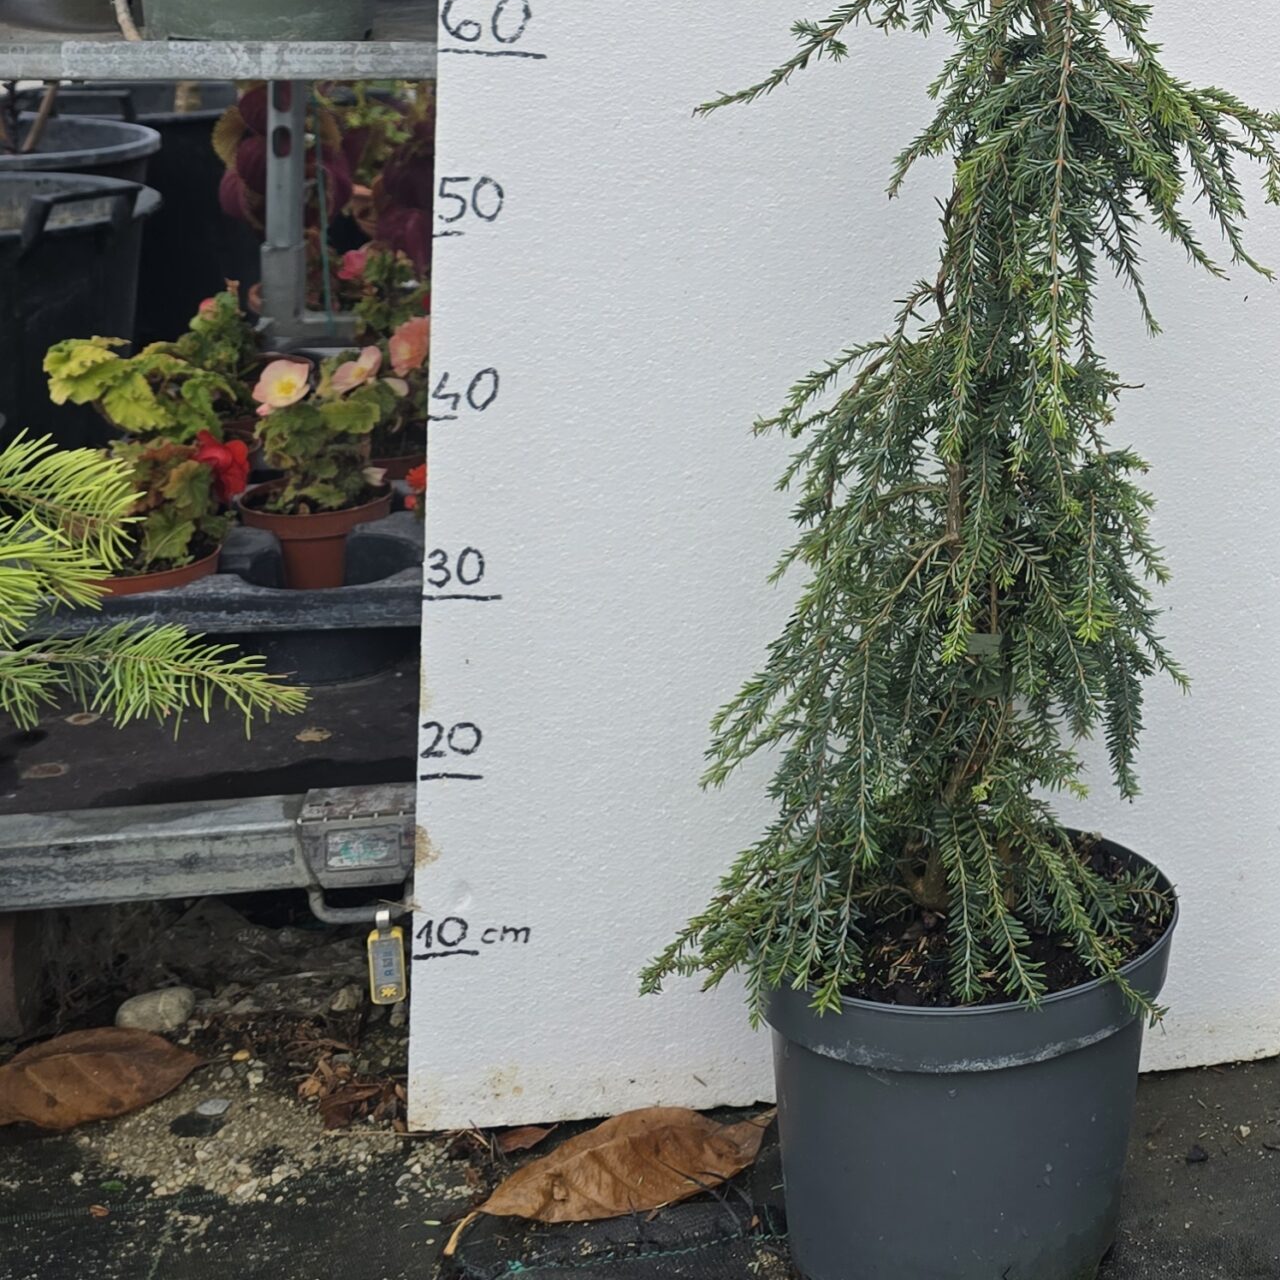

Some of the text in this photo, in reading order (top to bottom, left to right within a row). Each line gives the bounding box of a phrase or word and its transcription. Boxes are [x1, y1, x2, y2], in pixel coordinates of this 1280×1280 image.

[437, 176, 505, 223] 50
[431, 367, 500, 412] 40
[427, 546, 486, 589] 30
[419, 720, 483, 759] 20
[415, 916, 532, 949] 10 cm
